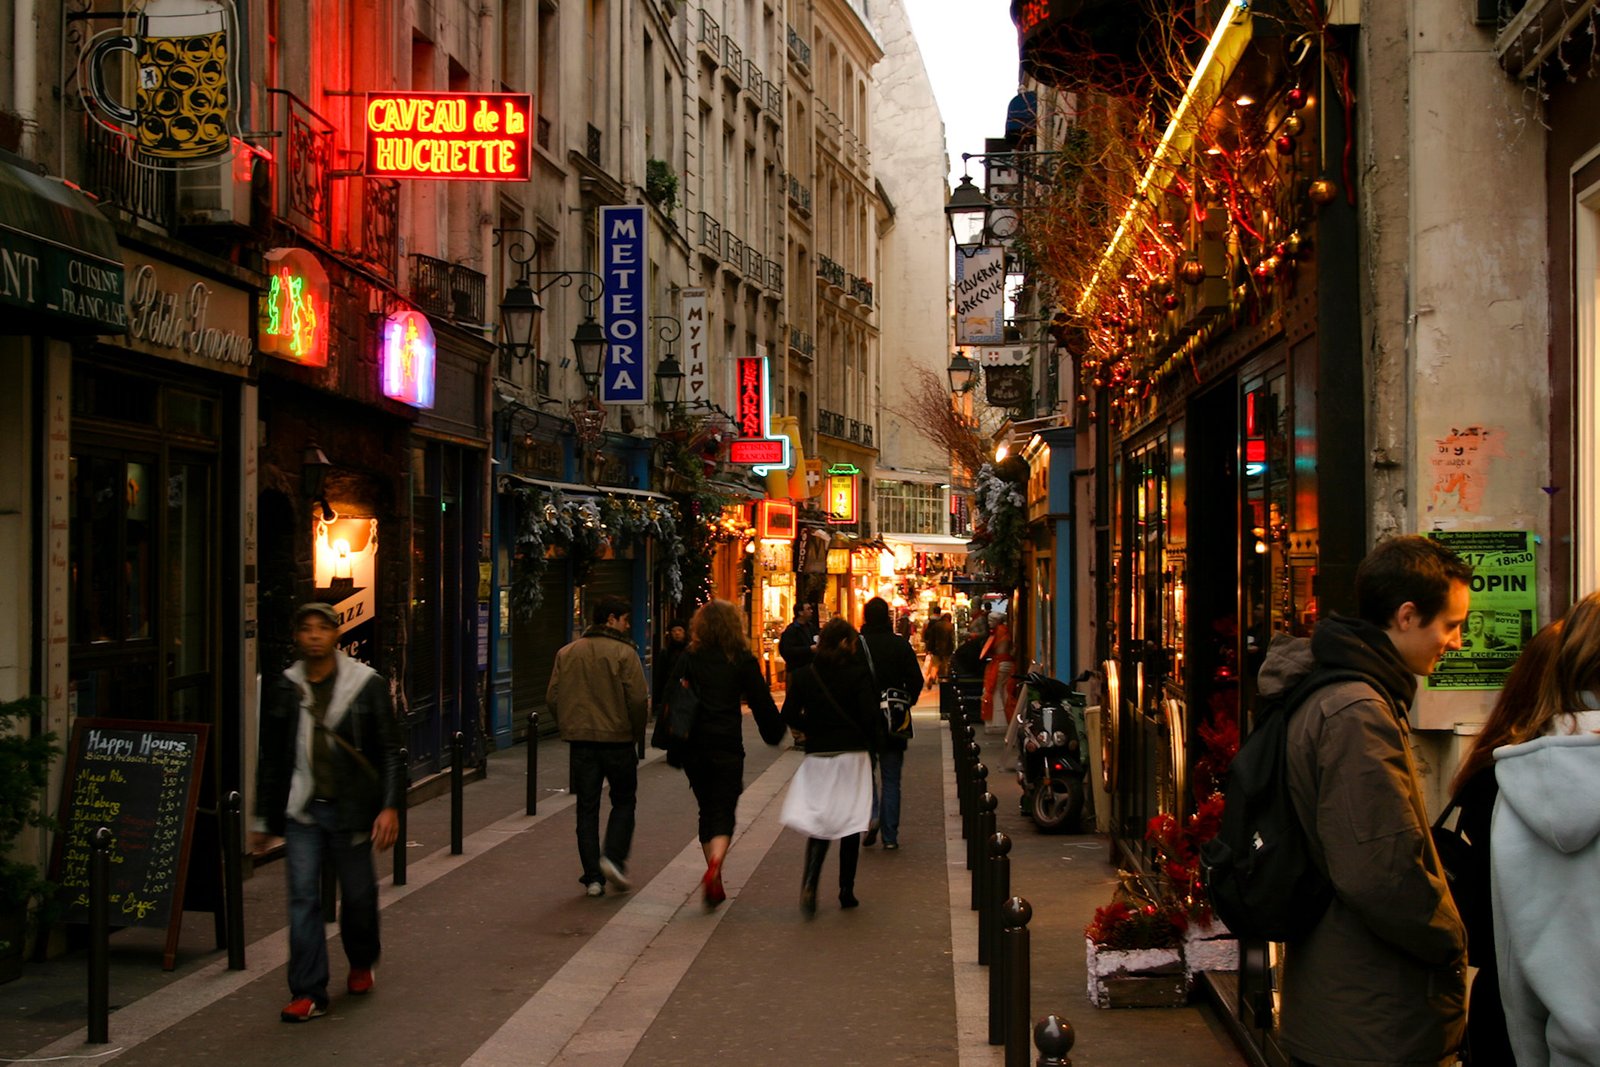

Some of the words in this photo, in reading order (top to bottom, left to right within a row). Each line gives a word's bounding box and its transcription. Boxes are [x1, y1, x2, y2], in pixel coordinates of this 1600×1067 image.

[368, 99, 466, 133] CAVEAU
[473, 100, 499, 132] de
[506, 102, 525, 134] la
[376, 137, 516, 173] HUCHETTE
[68, 259, 119, 294] CUISINE
[958, 259, 1002, 295] TAVERNE
[610, 219, 637, 390] METEORA
[957, 280, 1002, 315] GRECQUE
[1469, 575, 1527, 593] OPIN
[88, 729, 134, 756] Happy
[139, 732, 187, 755] Hours
